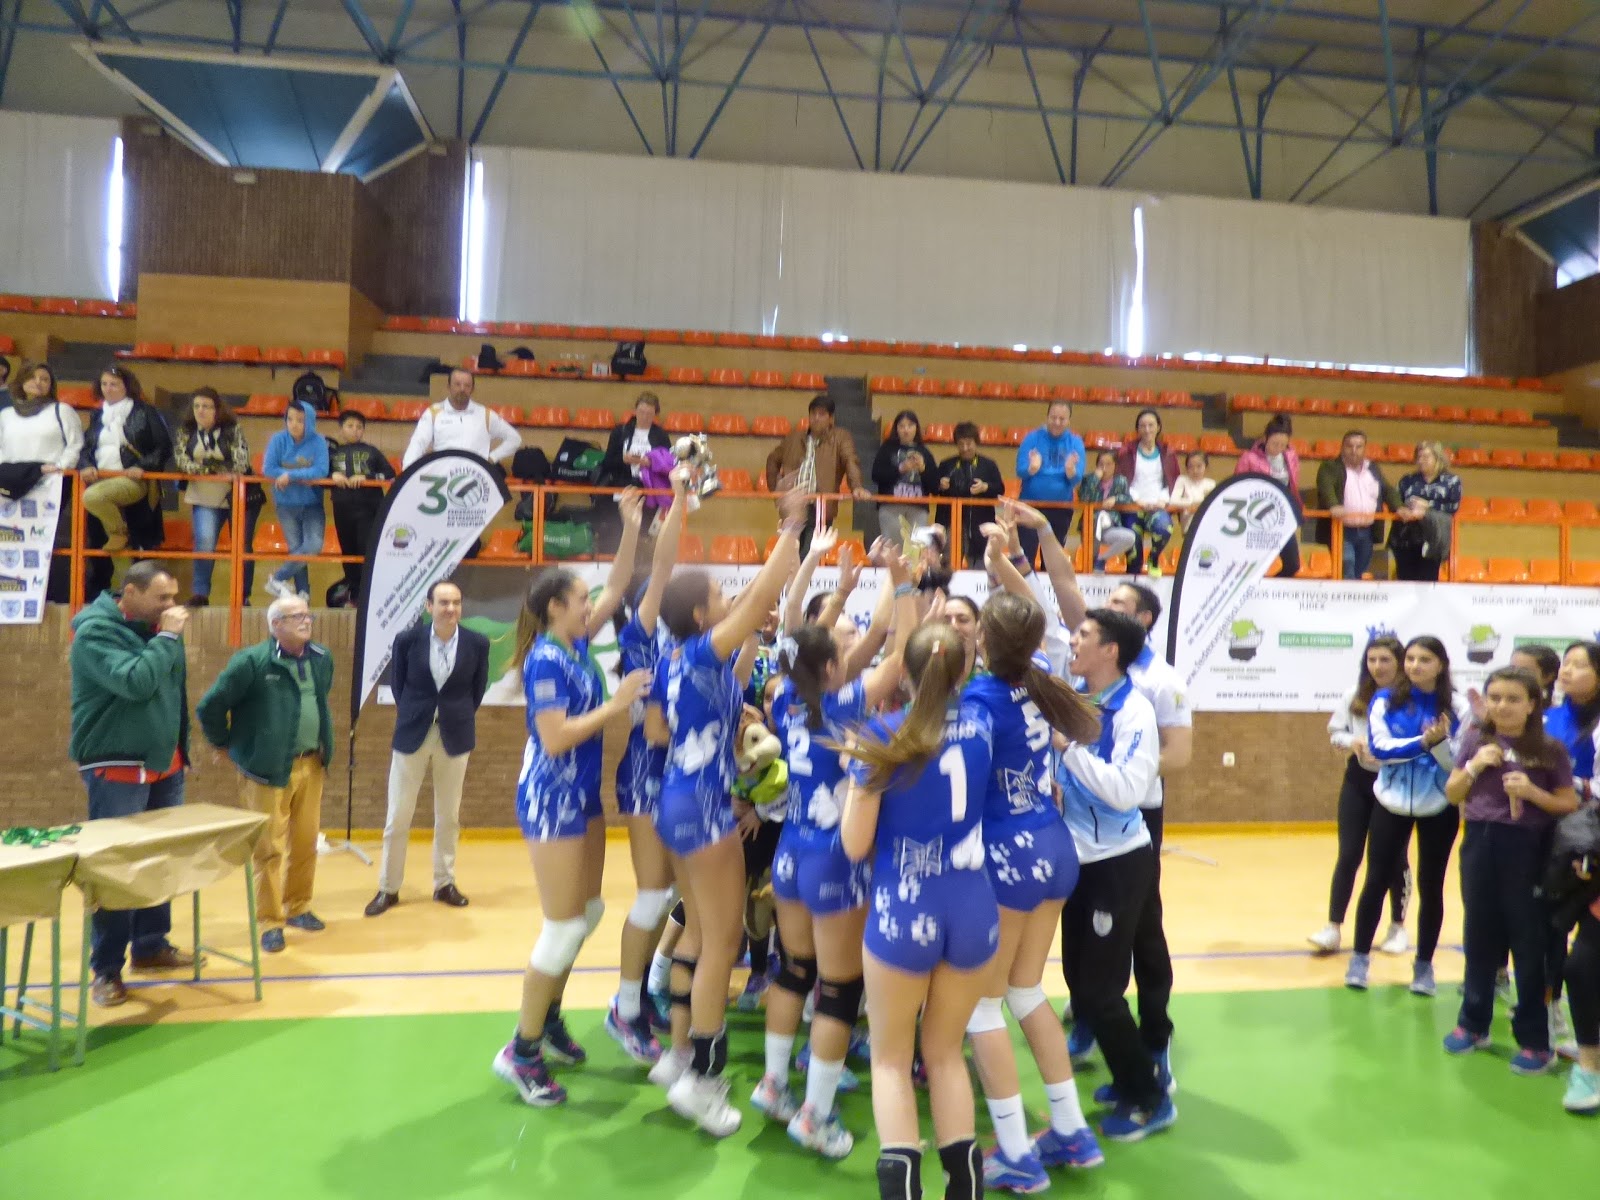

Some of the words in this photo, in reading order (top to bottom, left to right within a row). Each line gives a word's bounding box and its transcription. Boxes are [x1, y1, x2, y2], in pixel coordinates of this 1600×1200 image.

[786, 727, 814, 777] 2
[1021, 701, 1051, 753] 5
[939, 744, 967, 823] 1
